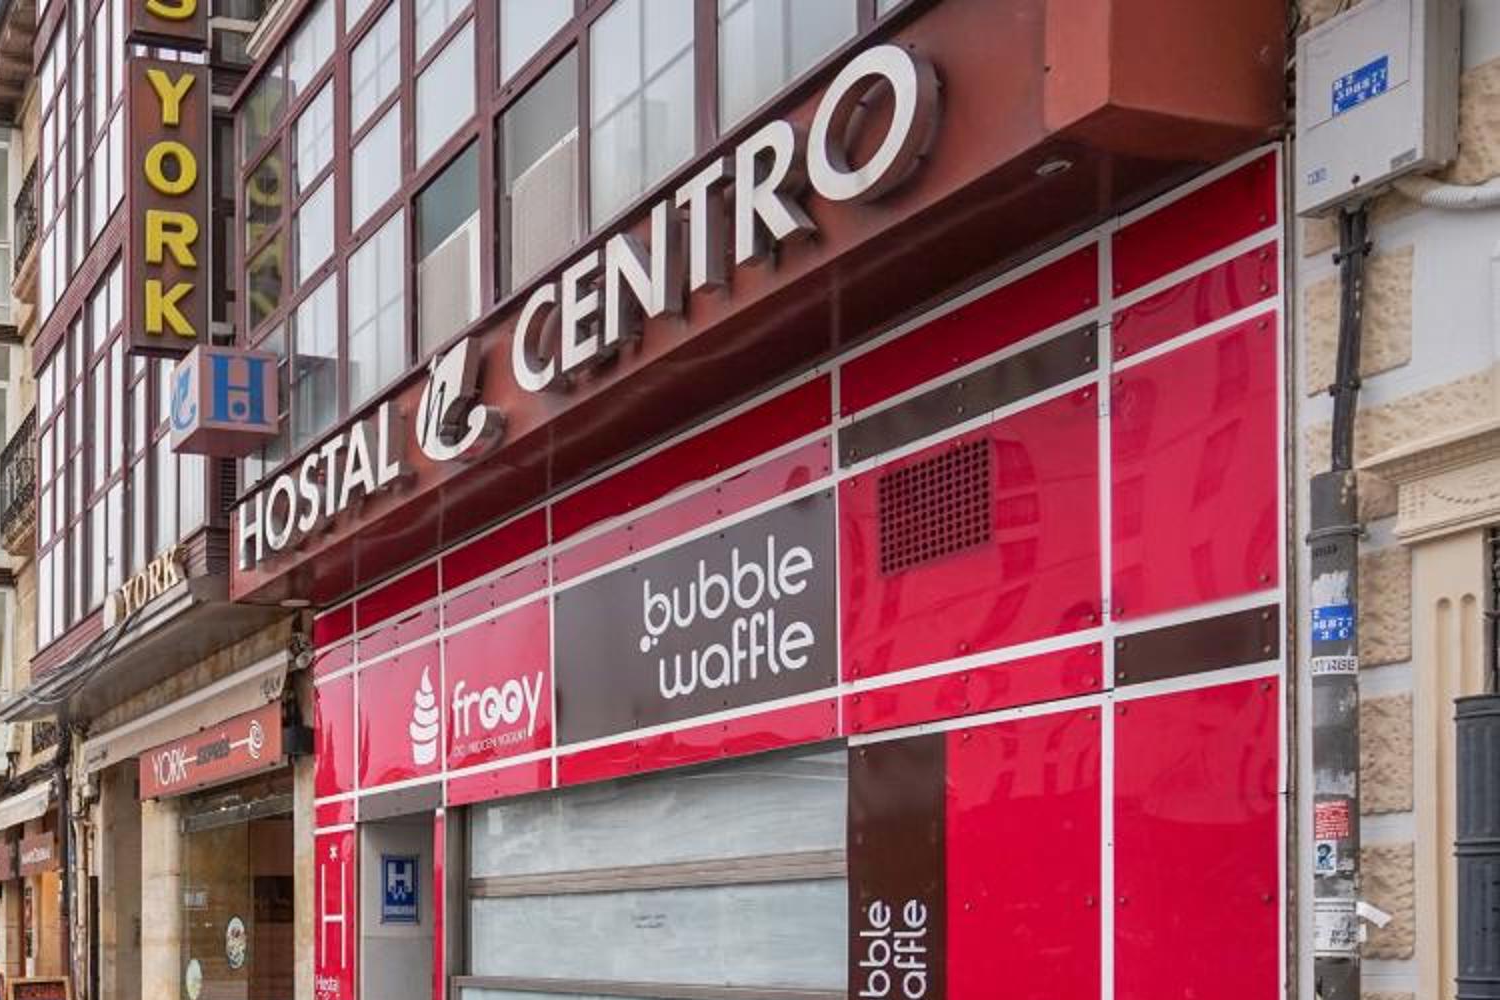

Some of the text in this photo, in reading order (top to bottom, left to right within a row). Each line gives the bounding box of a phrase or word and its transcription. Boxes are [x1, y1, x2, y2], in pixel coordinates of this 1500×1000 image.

[144, 69, 199, 337] YORK
[239, 400, 400, 571] HOSTAL
[511, 43, 919, 393] CENTRO
[121, 543, 184, 617] YORK
[642, 534, 814, 638] bubble
[659, 607, 816, 699] waffle
[451, 671, 544, 740] frooy
[151, 745, 188, 787] YORK
